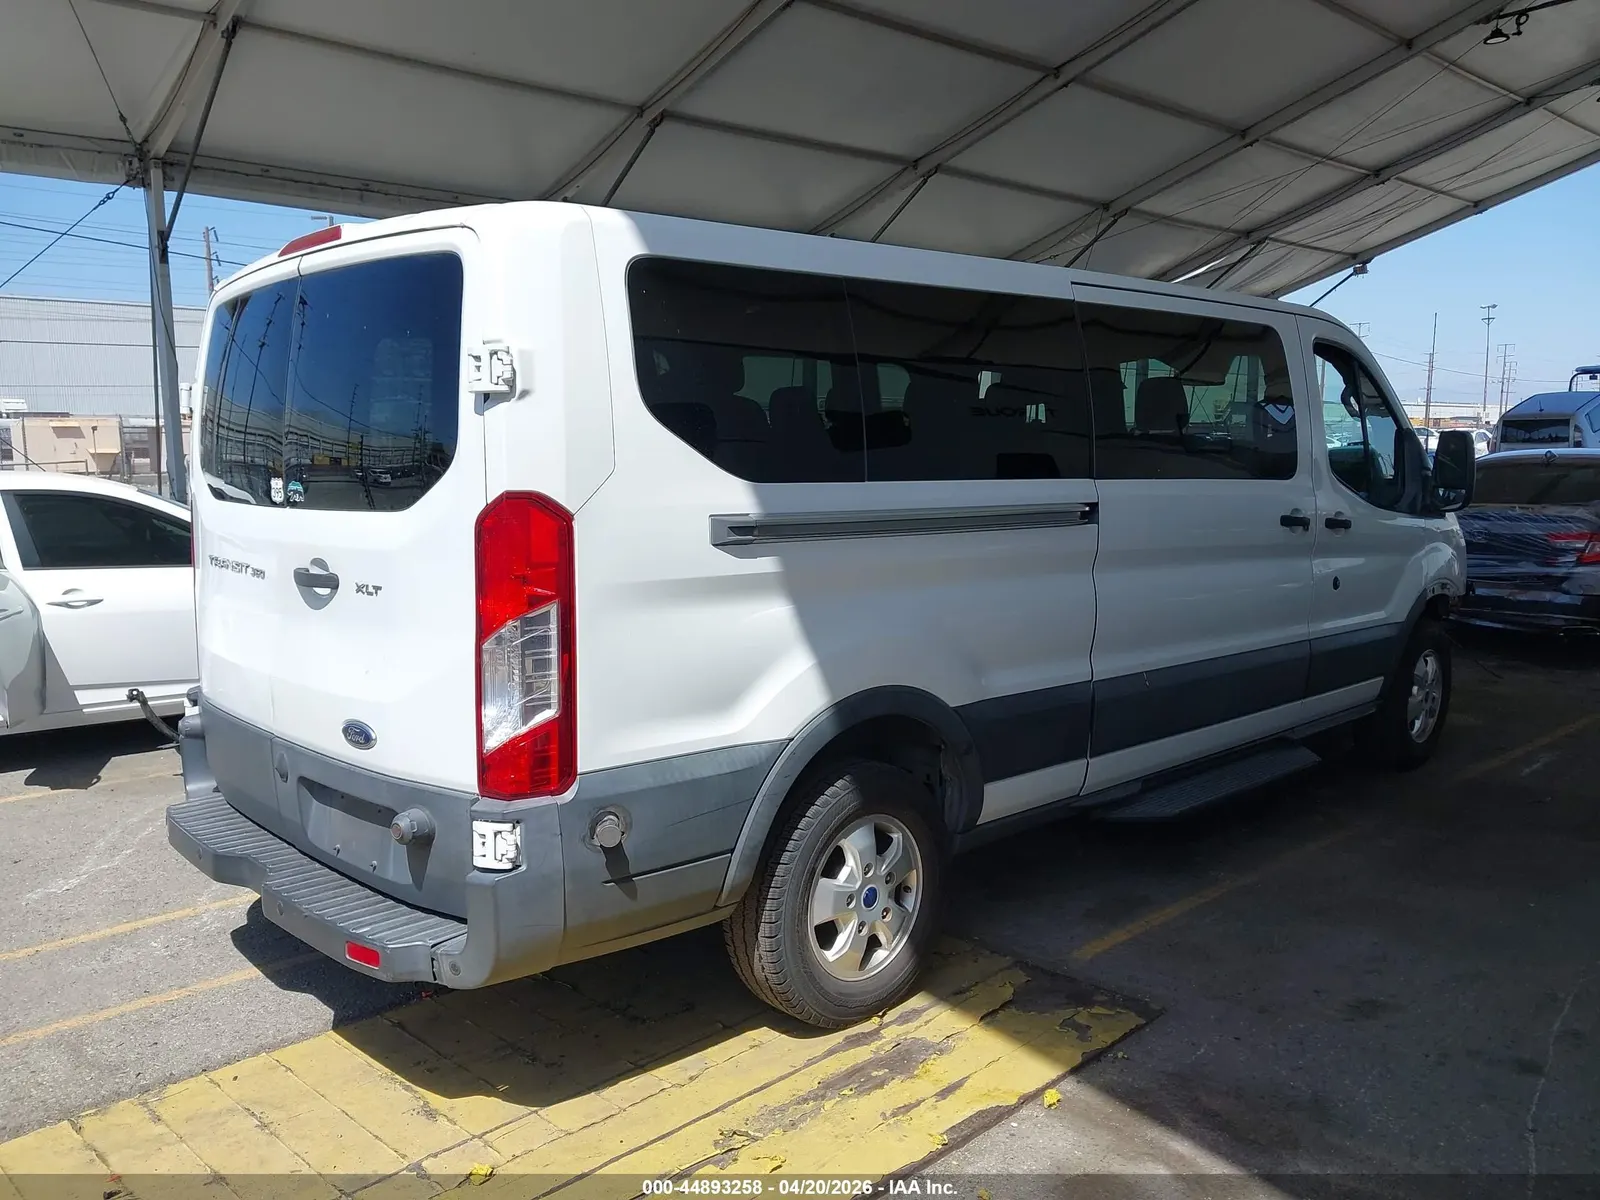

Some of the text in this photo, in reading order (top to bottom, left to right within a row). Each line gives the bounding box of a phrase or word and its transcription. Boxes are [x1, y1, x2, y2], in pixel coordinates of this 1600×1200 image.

[272, 487, 283, 499] 395
[208, 554, 266, 580] TRANSIT 350
[355, 582, 383, 597] XLT
